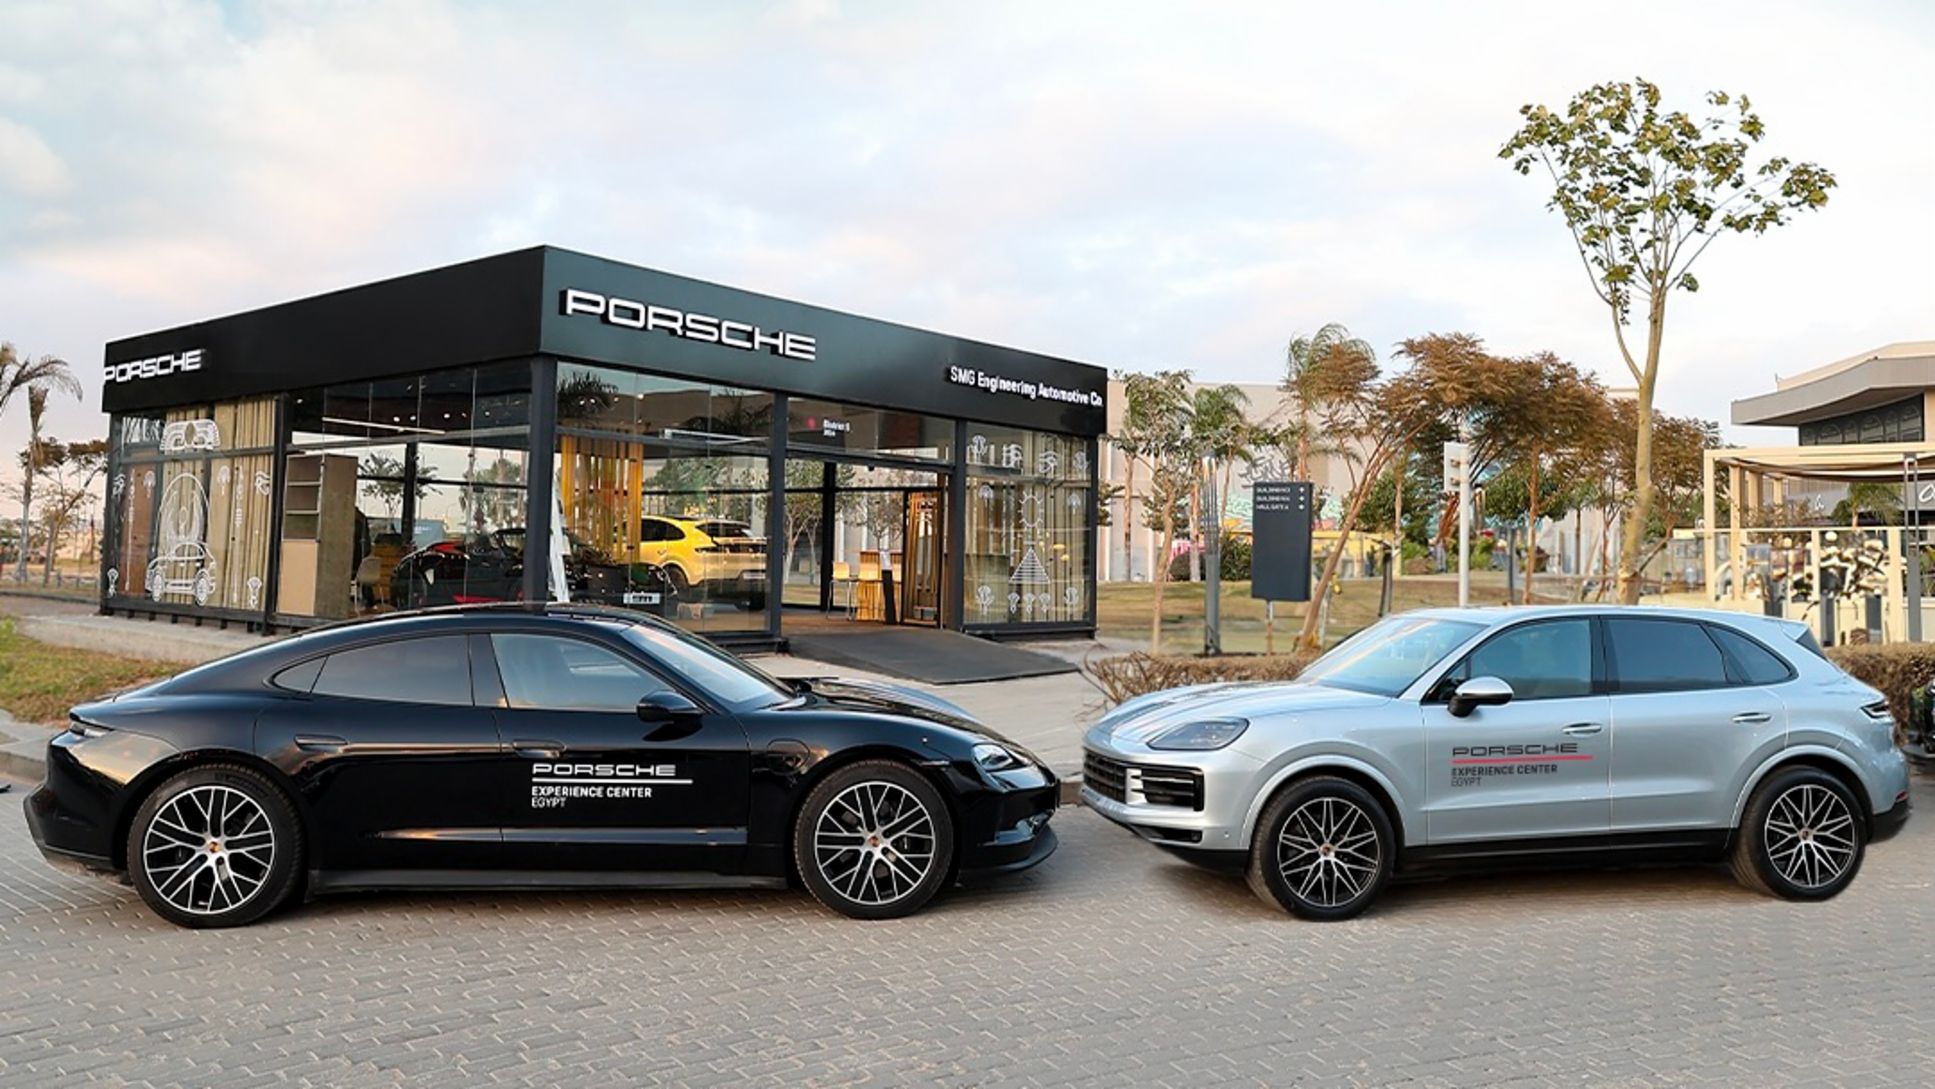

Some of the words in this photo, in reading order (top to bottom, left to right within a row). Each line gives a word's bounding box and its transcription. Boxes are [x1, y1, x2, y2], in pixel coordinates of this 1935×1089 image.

[565, 288, 817, 361] PORSCHE
[103, 348, 203, 383] PORSCHE
[950, 365, 976, 386] SMG
[977, 371, 1037, 400] Engineering
[1037, 382, 1089, 405] Automotive
[1451, 742, 1578, 757] PORSCHE
[531, 762, 677, 777] PORSCHE
[1450, 765, 1515, 777] EXPERIENCE
[1516, 764, 1559, 775] CENTER
[1450, 776, 1482, 787] EGYPT
[531, 785, 604, 798] EXPERIENCE
[606, 786, 653, 798] CENTER
[531, 796, 568, 808] EGYPT
